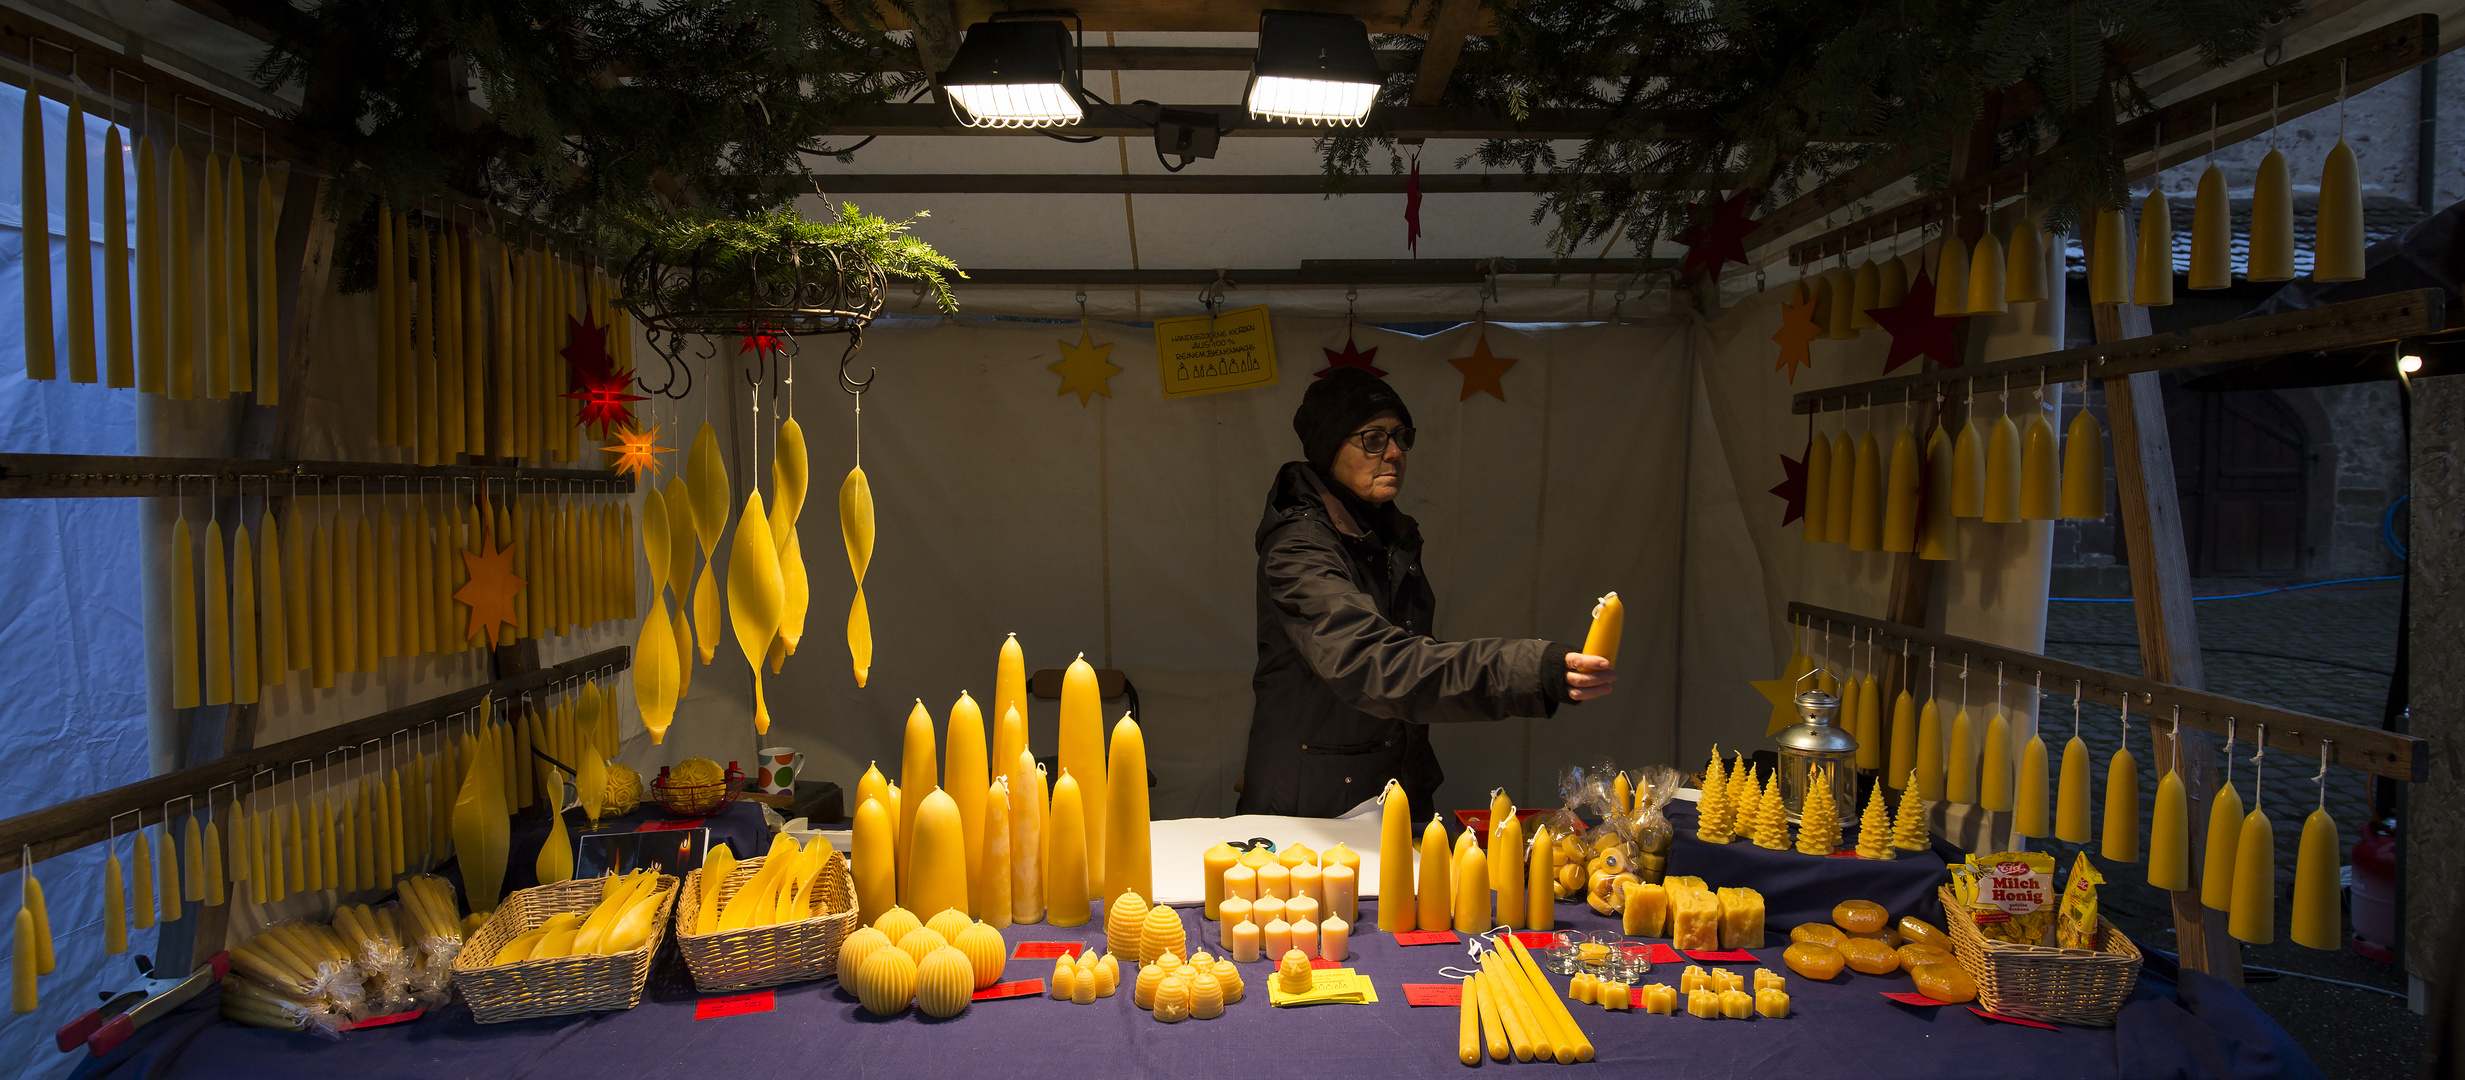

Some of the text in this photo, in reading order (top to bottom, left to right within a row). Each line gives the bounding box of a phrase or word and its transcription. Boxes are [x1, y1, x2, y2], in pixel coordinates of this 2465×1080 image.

[1192, 341, 1210, 349] AUS
[1211, 339, 1227, 347] 100
[1175, 352, 1206, 360] REINEM
[1993, 877, 2040, 889] Milch
[1991, 890, 2043, 904] Honig
